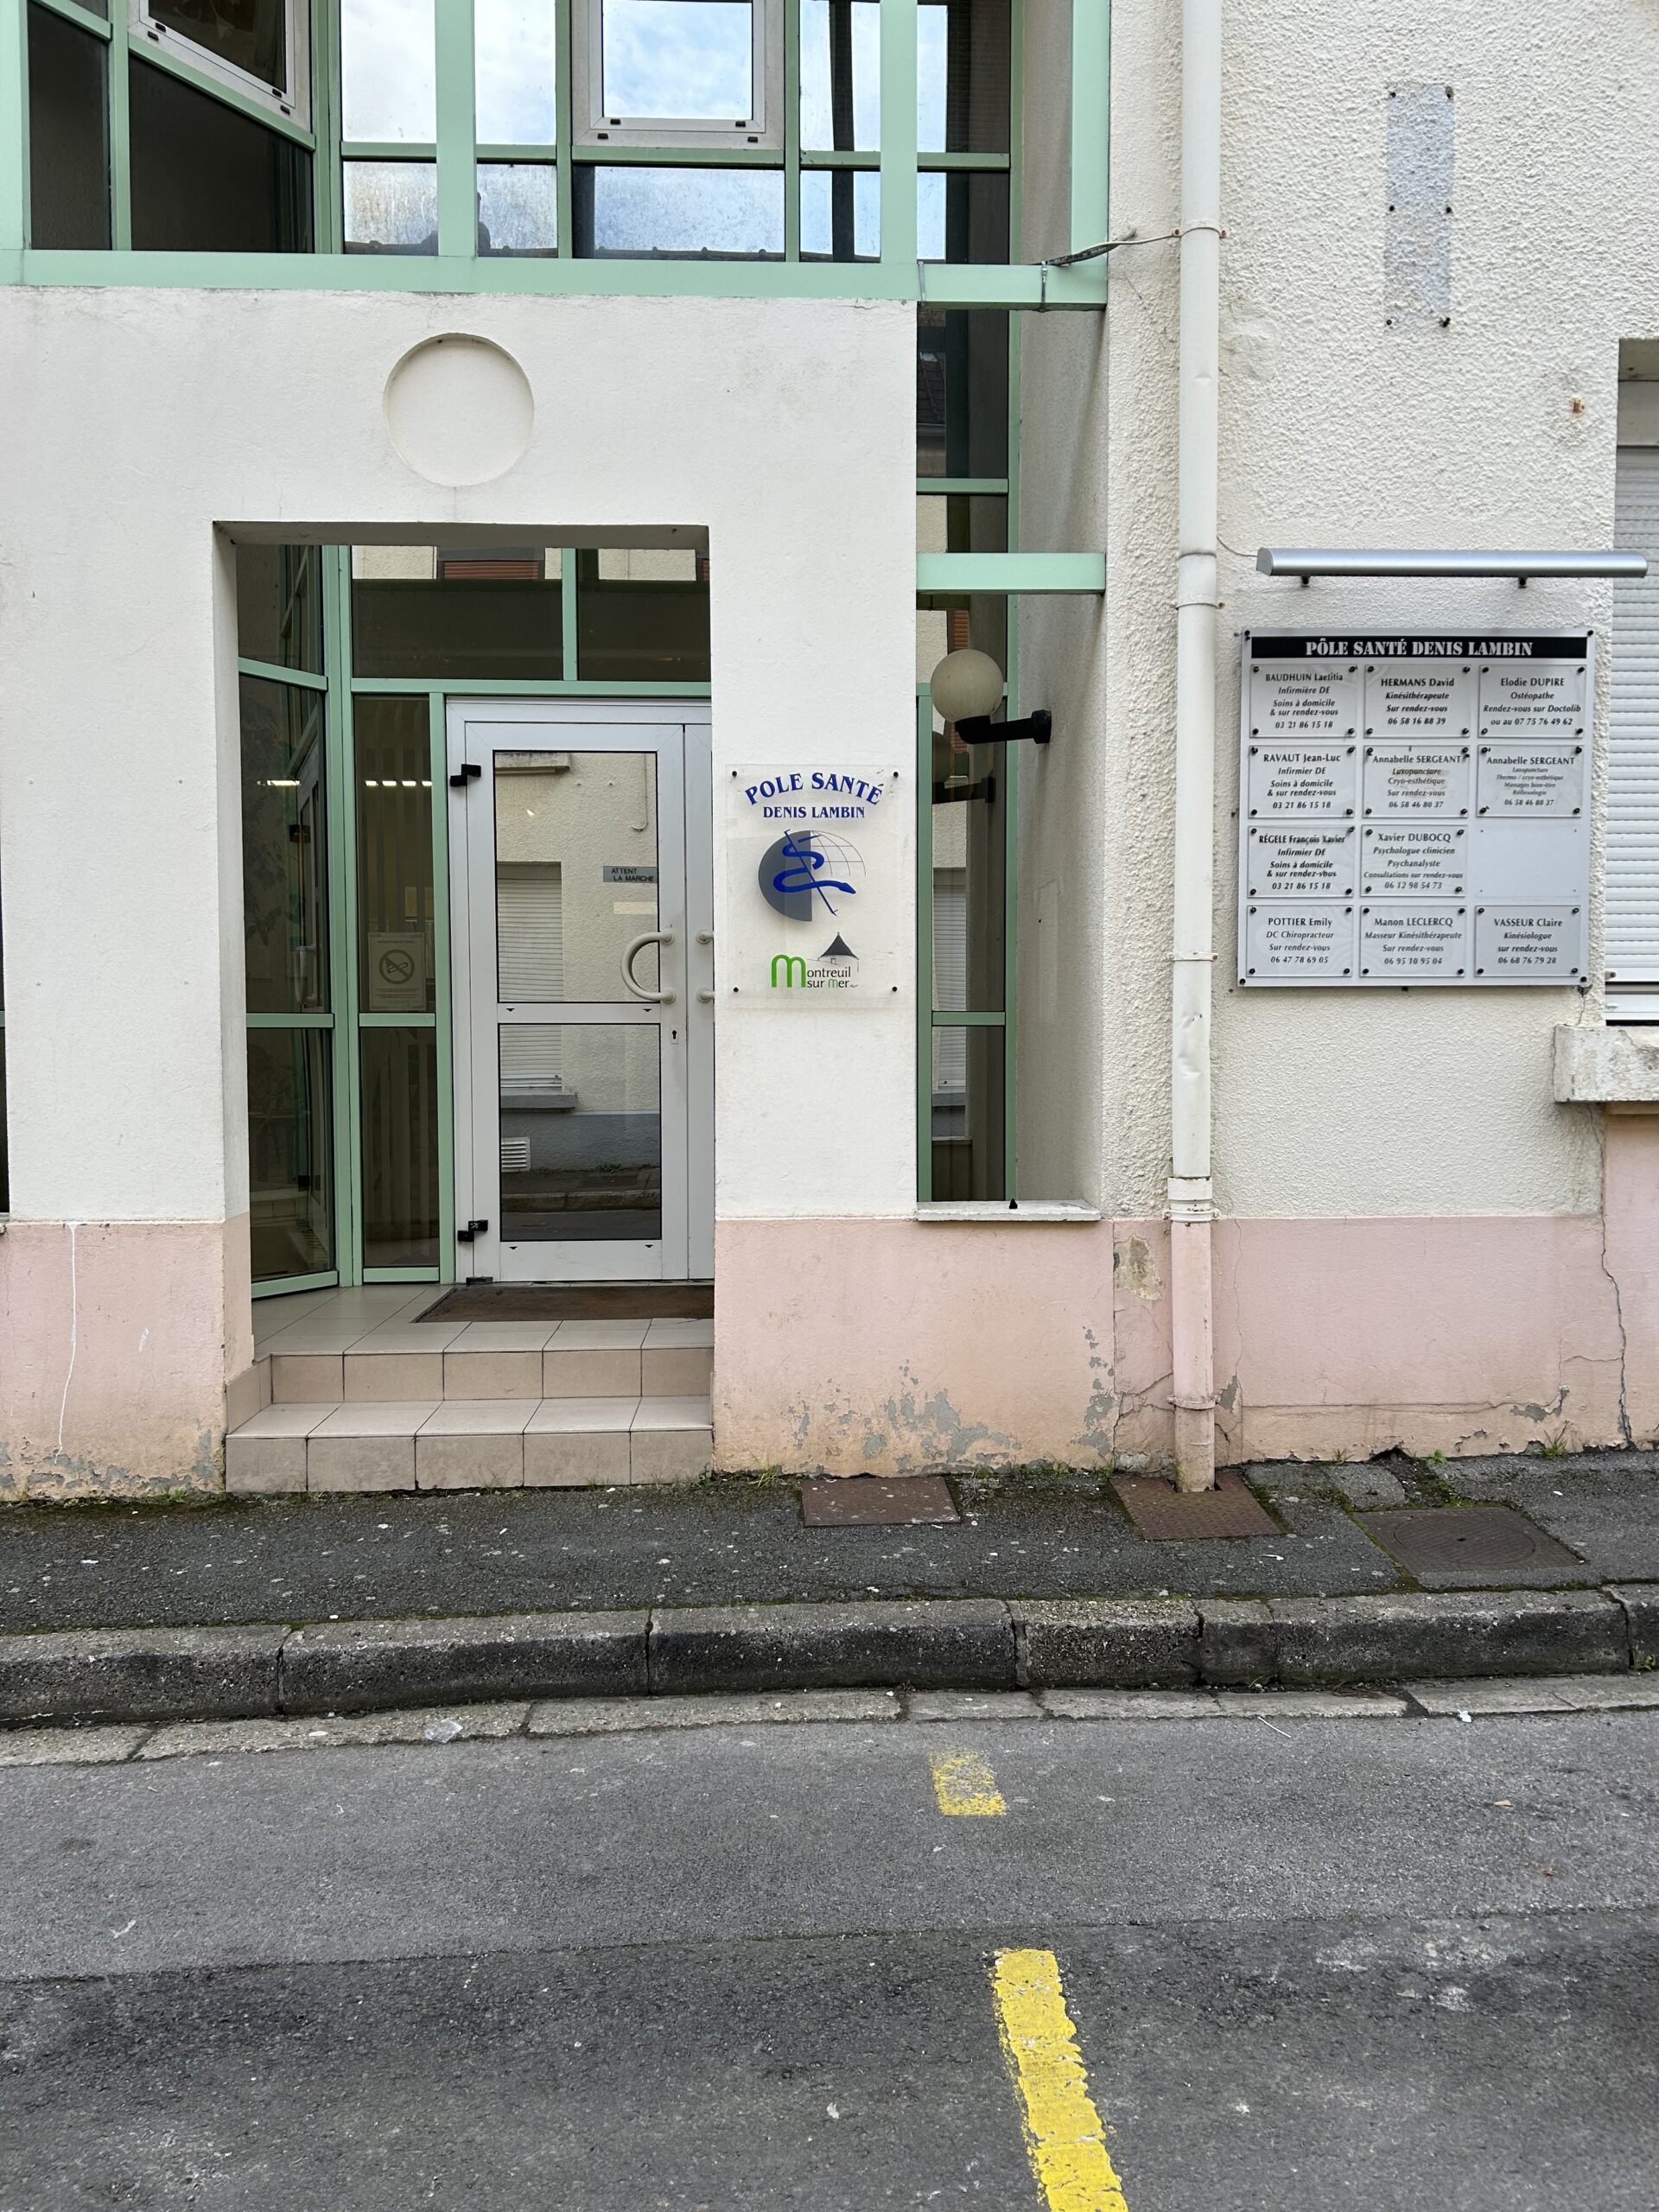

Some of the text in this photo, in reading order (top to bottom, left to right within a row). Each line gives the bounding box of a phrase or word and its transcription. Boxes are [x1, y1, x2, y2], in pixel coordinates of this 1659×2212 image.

[1306, 638, 1533, 656] PÔLE SANTÉ DENIS LAMBIN
[1501, 677, 1528, 686] Elodie
[1386, 691, 1449, 701] Kinésithérapeute
[1510, 692, 1554, 701] Ostéopathe
[1263, 753, 1341, 762] RAVAUT Jean-Luc
[745, 772, 884, 805] POLE SANTÉ
[763, 806, 866, 818] DENIS LAMBIN
[1259, 833, 1287, 843] RÉGELE
[1289, 835, 1320, 844] François
[1408, 834, 1452, 842] DUBOCQ
[1373, 847, 1421, 855] Psychologue
[1388, 860, 1440, 868] Psychanalyste
[1309, 918, 1332, 928] Emily
[1407, 918, 1453, 927] LECLERCQ
[1399, 931, 1462, 940] Kinésithérapeute
[1504, 932, 1553, 941] Kinésiologue
[807, 980, 825, 988] sur
